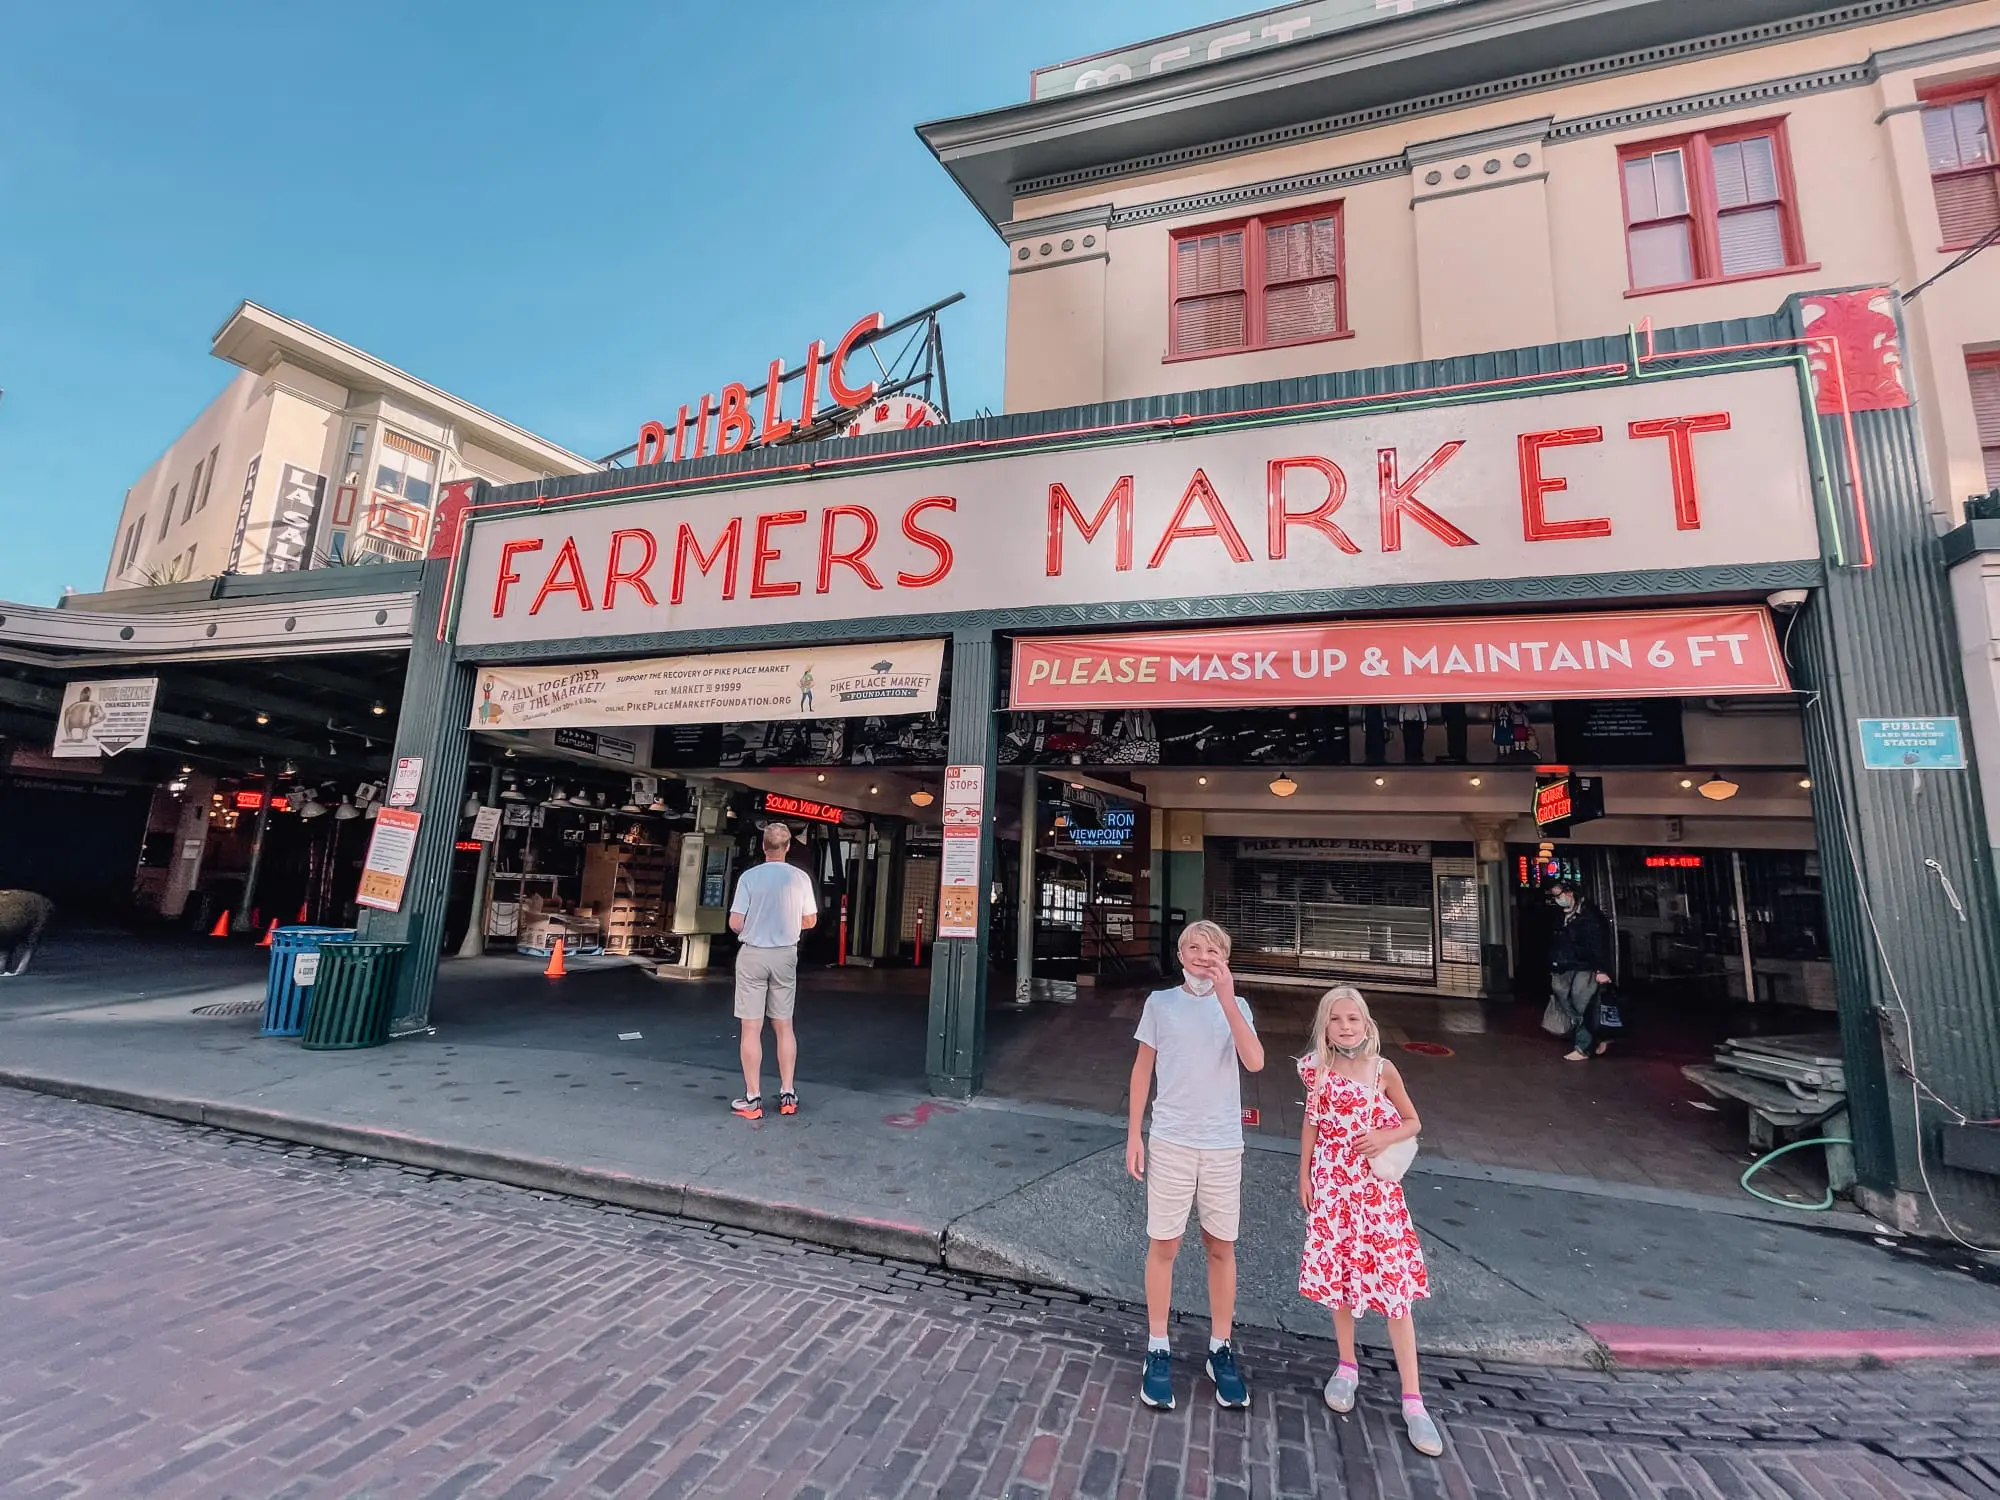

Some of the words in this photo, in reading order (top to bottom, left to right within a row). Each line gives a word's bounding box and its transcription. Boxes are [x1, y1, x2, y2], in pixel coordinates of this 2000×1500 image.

[875, 403, 890, 423] 12
[492, 495, 958, 618] FARMERS
[1046, 410, 1731, 578] MARKET
[1027, 655, 1161, 686] PLEASE
[1168, 650, 1281, 683] MASK
[1291, 648, 1348, 679] UP
[1359, 646, 1391, 677] &
[1402, 638, 1633, 676] MAINTAIN
[1647, 639, 1675, 669] 6
[1687, 633, 1749, 667] FT
[616, 673, 648, 683] SUPPORT
[649, 671, 662, 680] THE
[662, 670, 701, 680] RECOVERY
[702, 669, 713, 677] OF
[714, 667, 731, 676] PIKE
[732, 666, 757, 675] PLACE
[758, 665, 790, 674] MARKET
[500, 685, 535, 701] RALLY
[537, 669, 600, 694] TOGETHER
[670, 684, 704, 695] MARKET
[714, 682, 742, 693] 91999
[830, 682, 851, 693] PIKE
[855, 676, 887, 689] PLACE
[890, 677, 932, 689] MARKET
[530, 694, 551, 711] THE
[552, 682, 607, 704] MARKET!
[850, 689, 909, 700] FOUNDATION
[1881, 722, 1935, 731] PUBLIC
[947, 769, 959, 777] NO
[950, 780, 979, 790] STOPS
[765, 793, 799, 811] SOUND
[800, 800, 820, 816] VIEW
[1538, 799, 1571, 823] GROCERY
[1069, 828, 1132, 840] VIEWPOINT
[1287, 837, 1340, 849] PLACE
[1348, 838, 1423, 856] BAKERY
